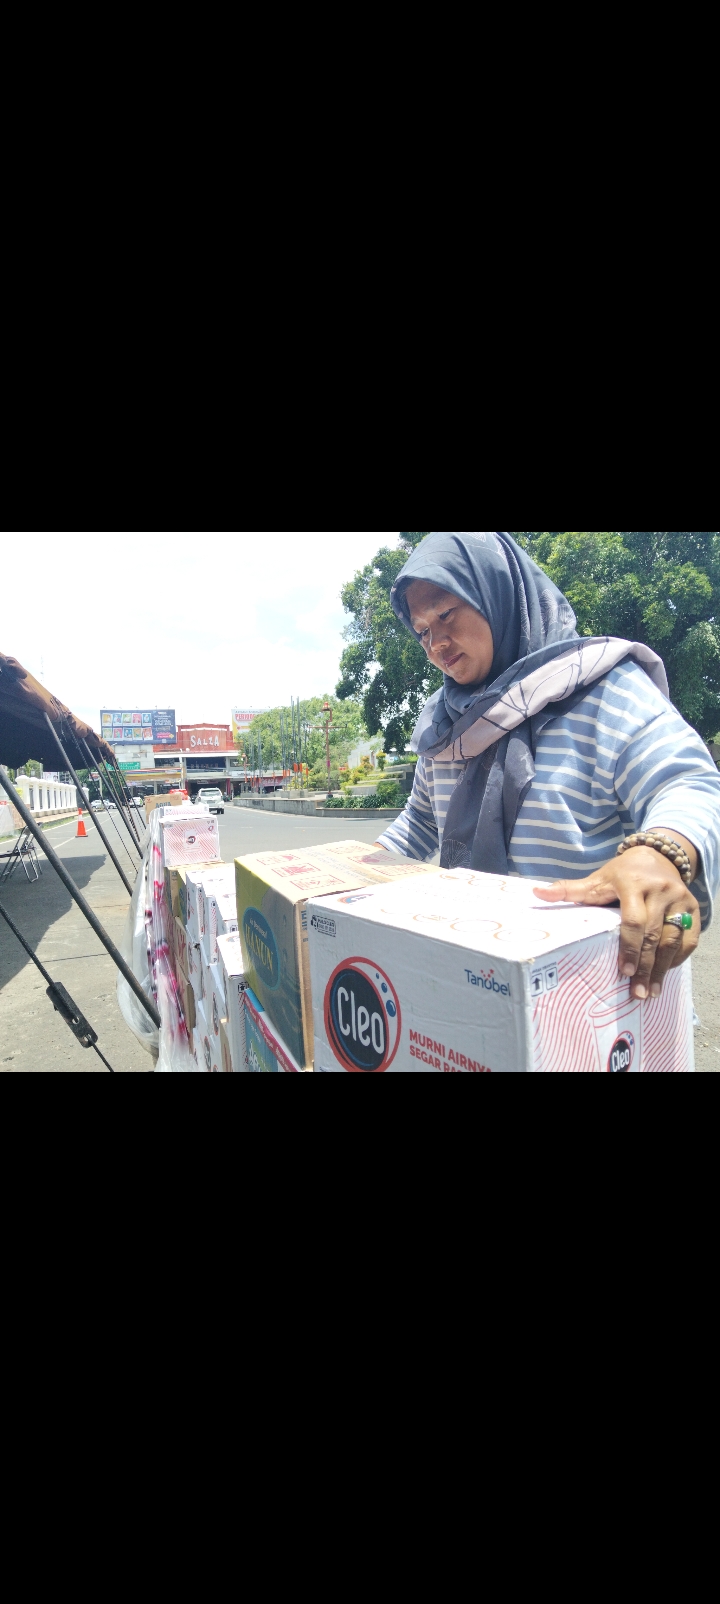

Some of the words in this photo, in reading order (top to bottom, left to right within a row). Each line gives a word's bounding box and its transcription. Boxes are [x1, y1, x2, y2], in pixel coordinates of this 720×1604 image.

[190, 735, 220, 748] SALZA
[464, 968, 511, 996] Tanobel
[337, 986, 385, 1054] Cleo
[409, 1029, 445, 1058] MURNI
[409, 1045, 441, 1070] SEGAR
[611, 1049, 630, 1072] Cleo
